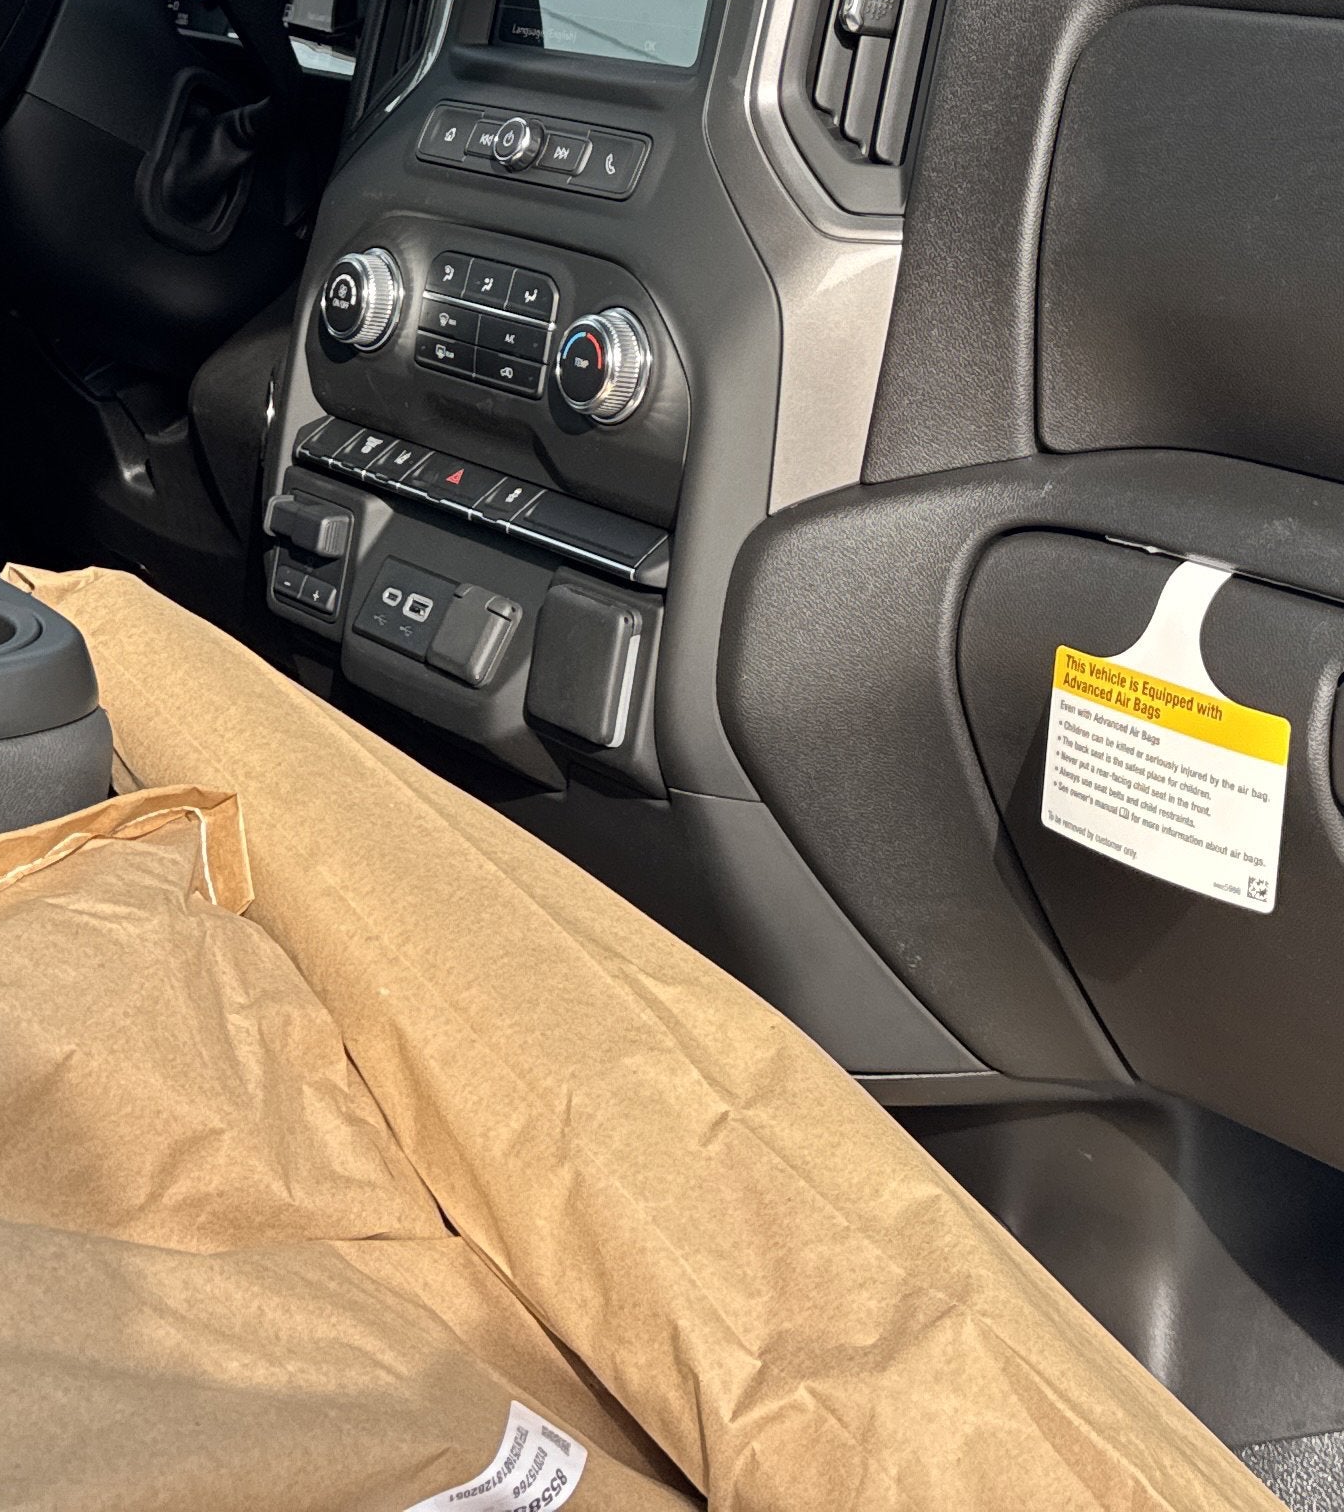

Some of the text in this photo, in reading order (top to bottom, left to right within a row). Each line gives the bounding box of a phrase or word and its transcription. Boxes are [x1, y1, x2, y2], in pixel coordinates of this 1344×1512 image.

[1063, 672, 1160, 719] Advanced Air Bags
[1066, 654, 1222, 721] This Vehicle is Equipped with
[1060, 700, 1160, 746] Even with Advanced Air Bags
[1061, 751, 1078, 765] Never
[1079, 761, 1089, 770] put
[1096, 768, 1132, 789] rear-facing
[1133, 782, 1150, 794] child
[1151, 789, 1166, 800] seat
[1168, 794, 1175, 804] in
[1177, 797, 1189, 809] the
[1191, 802, 1211, 816] front.
[1063, 736, 1211, 800] The back seat is the safest place for children.
[1064, 721, 1090, 738] Children
[1092, 734, 1103, 744] can
[1106, 737, 1114, 748] be
[1116, 741, 1135, 755] killed
[1145, 754, 1178, 773] seriously
[1181, 764, 1207, 782] injured
[1210, 774, 1219, 787] by
[1222, 779, 1235, 790] the
[1237, 785, 1249, 795] air
[1252, 788, 1270, 803] bag.
[1048, 810, 1054, 821] To
[1087, 829, 1094, 841] by
[1058, 782, 1068, 793] See
[1131, 813, 1141, 823] for
[1142, 819, 1159, 831] more
[1162, 826, 1203, 847] information
[1205, 842, 1228, 855] about
[1230, 849, 1241, 859] air
[1243, 852, 1265, 867] bags.
[1059, 767, 1195, 828] Always use seat belts and child restraints.
